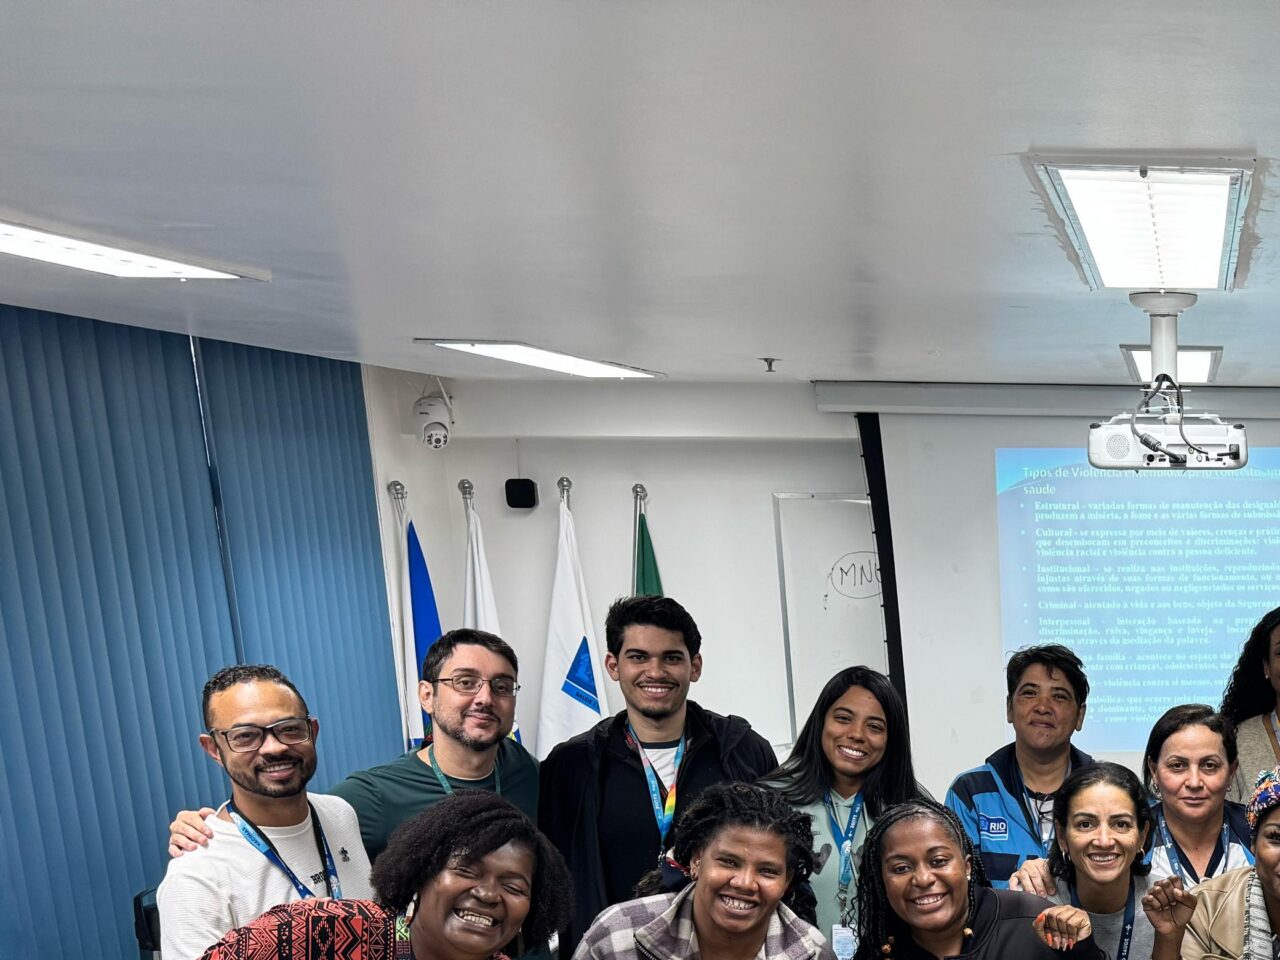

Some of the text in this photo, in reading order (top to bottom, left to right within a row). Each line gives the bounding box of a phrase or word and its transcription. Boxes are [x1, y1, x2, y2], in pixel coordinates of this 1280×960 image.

[1023, 467, 1052, 479] Tipos
[1055, 467, 1069, 477] de
[1023, 483, 1055, 495] saúde
[1035, 501, 1079, 510] Estrutural
[1088, 501, 1124, 510] variadas
[1128, 501, 1156, 510] formas
[1159, 501, 1169, 509] de
[1172, 500, 1224, 511] manutenção
[1225, 500, 1240, 509] das
[1035, 511, 1078, 522] produzem
[1131, 510, 1152, 519] fome
[1172, 510, 1198, 519] várias
[1200, 510, 1229, 519] formas
[1231, 510, 1241, 518] de
[1036, 528, 1072, 537] Cultural
[1129, 529, 1144, 538] por
[1168, 528, 1178, 536] de
[989, 821, 1006, 831] RIO
